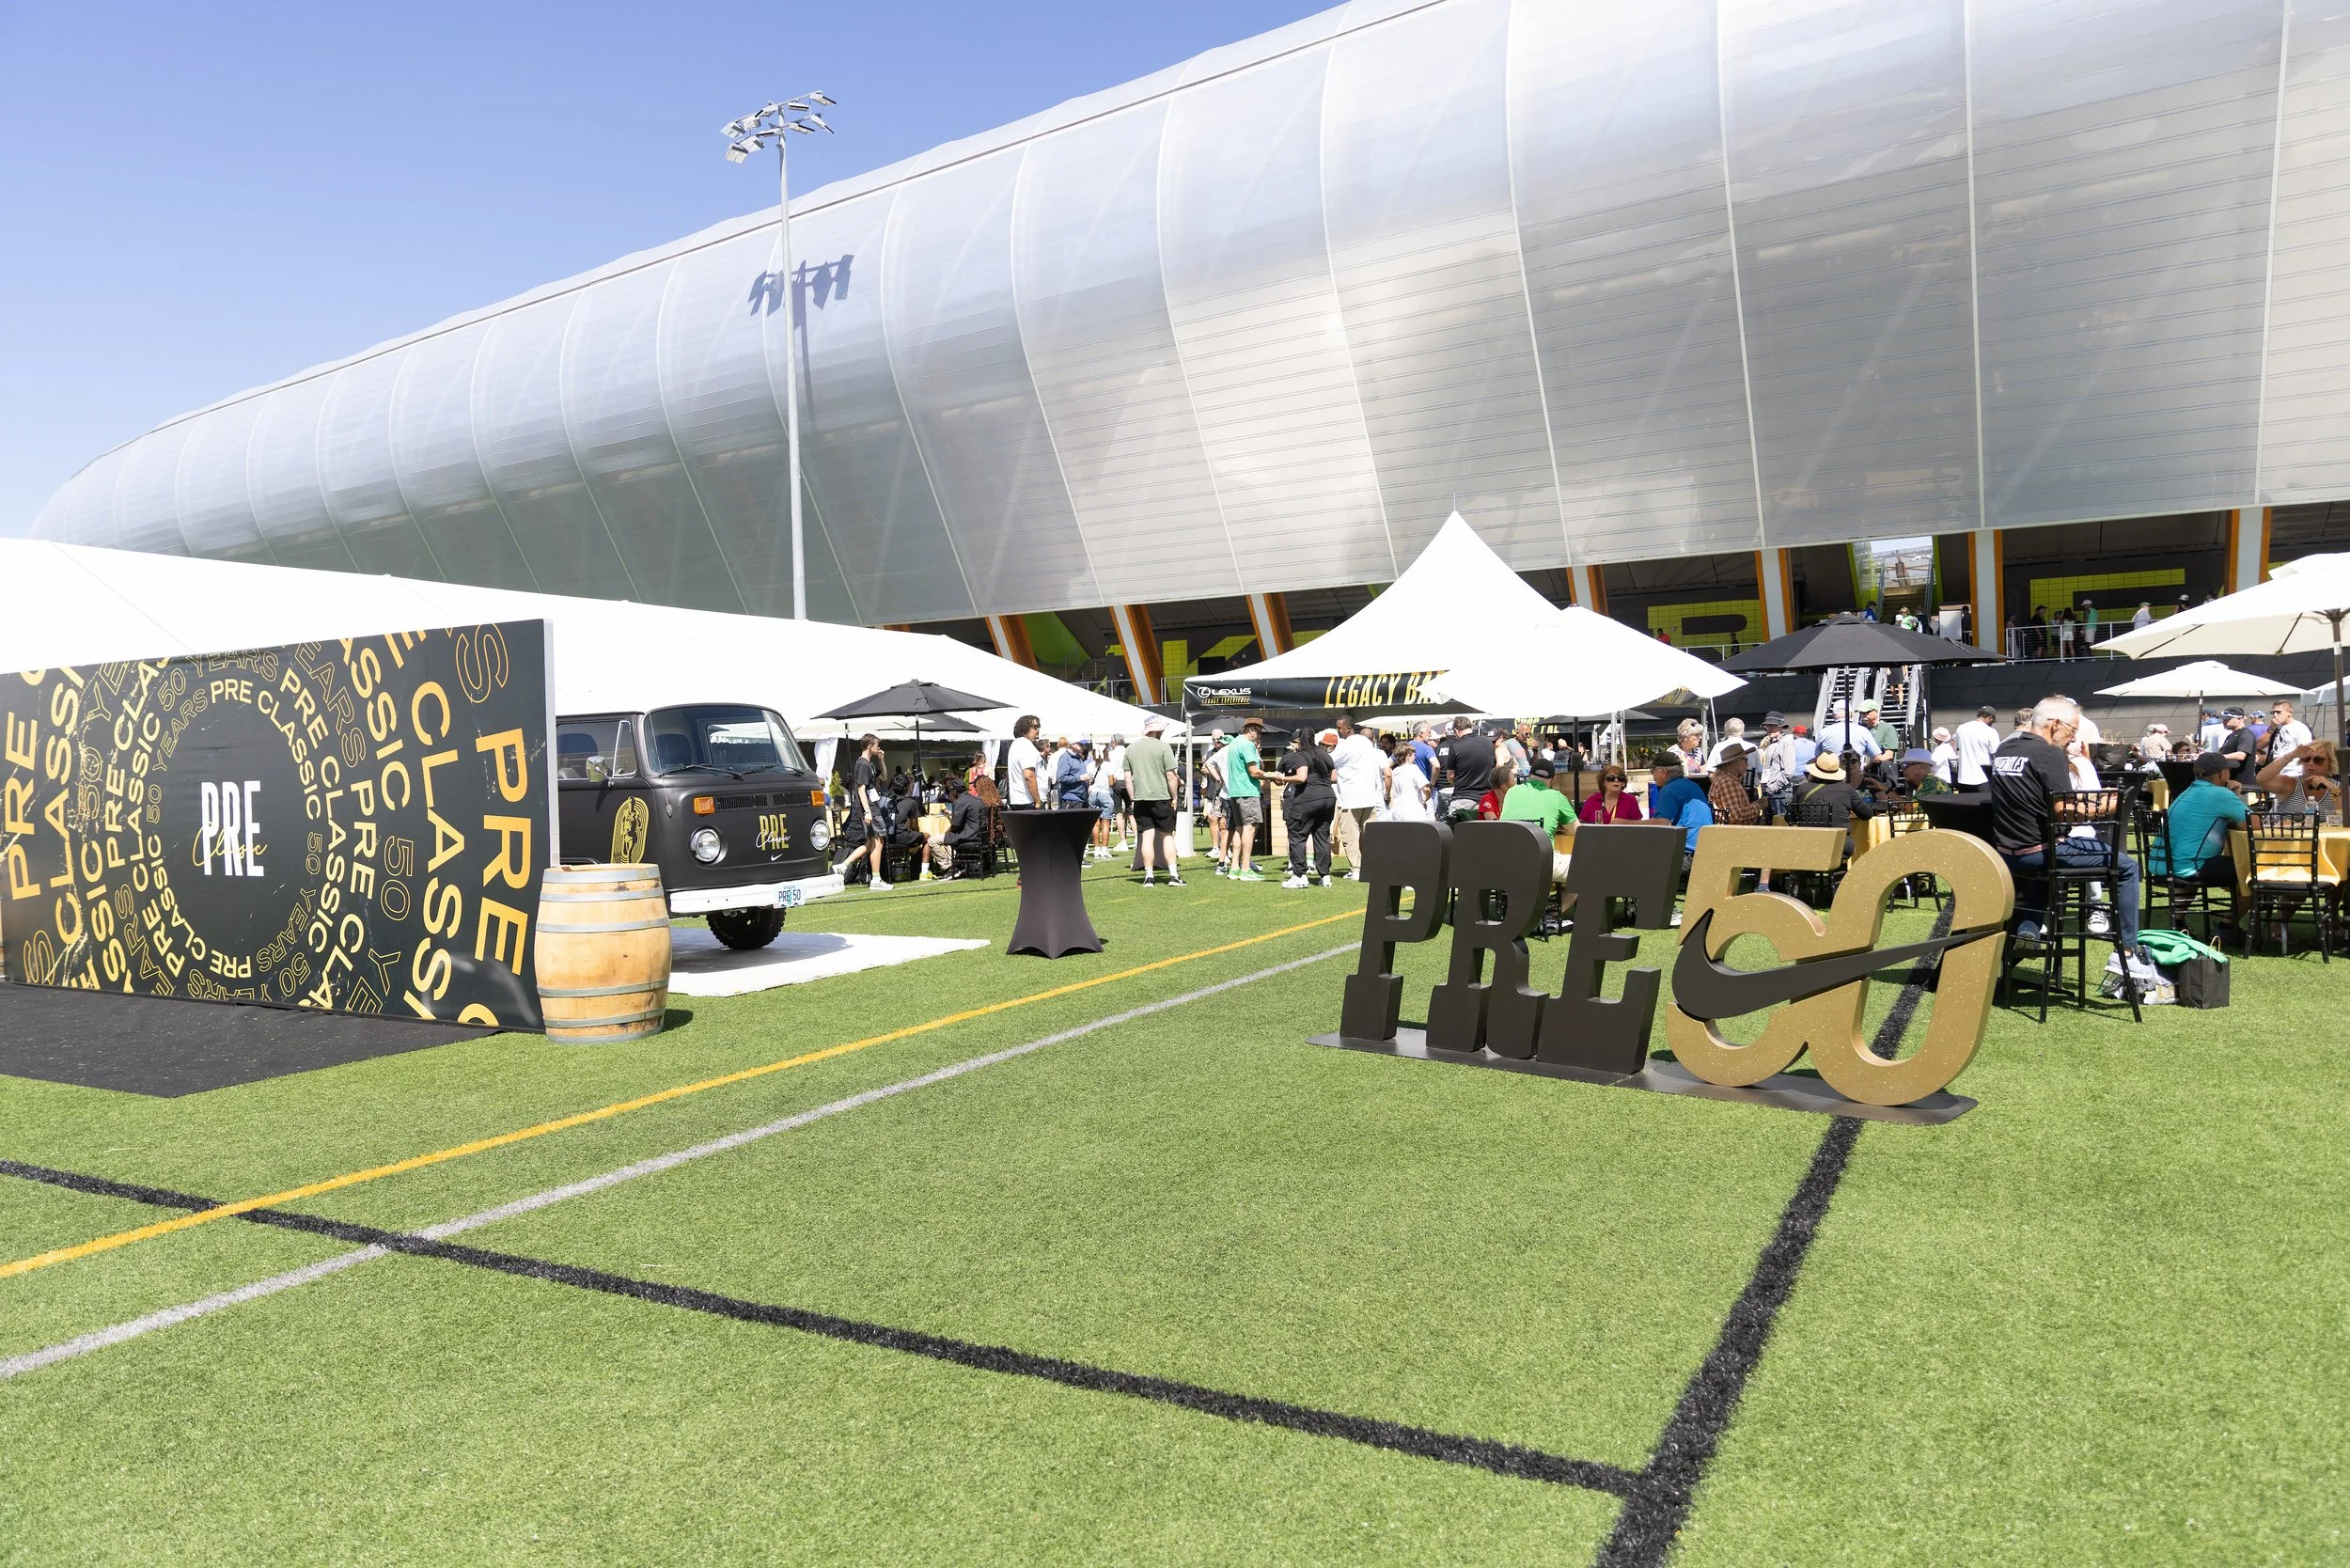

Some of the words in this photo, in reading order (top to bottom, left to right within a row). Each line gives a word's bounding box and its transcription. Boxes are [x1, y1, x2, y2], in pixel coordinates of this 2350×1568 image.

[158, 668, 186, 712] 50
[186, 649, 278, 682] YEARS
[211, 678, 253, 704] PRE
[280, 667, 329, 749] PRE
[282, 638, 366, 767] EARS
[1324, 673, 1402, 708] LEGACY
[1403, 669, 1446, 705] BA
[152, 689, 208, 771] YEARS
[258, 690, 321, 820] CLASSIC
[5, 712, 40, 900] PRE
[105, 763, 126, 868] PRE
[128, 713, 160, 892] CLASSIC
[146, 784, 162, 823] 50
[201, 780, 265, 877] PRE
[350, 779, 376, 900] PRE
[755, 830, 791, 848] Classic
[759, 813, 790, 851] PRE
[306, 831, 322, 875] 50
[308, 756, 347, 953] CLASSIC
[380, 835, 414, 921] 50
[475, 728, 532, 976] PRE
[81, 840, 133, 993] SSIC
[148, 834, 206, 960] CLASSIC
[256, 887, 316, 972] YEARS
[778, 889, 791, 902] PRE
[793, 888, 802, 901] 50
[142, 899, 185, 978] PRE
[209, 949, 252, 978] PRE
[279, 952, 311, 996] 50
[297, 913, 364, 1010] CLA
[1340, 821, 1687, 1074] PRE
[1666, 826, 2014, 1105] 50
